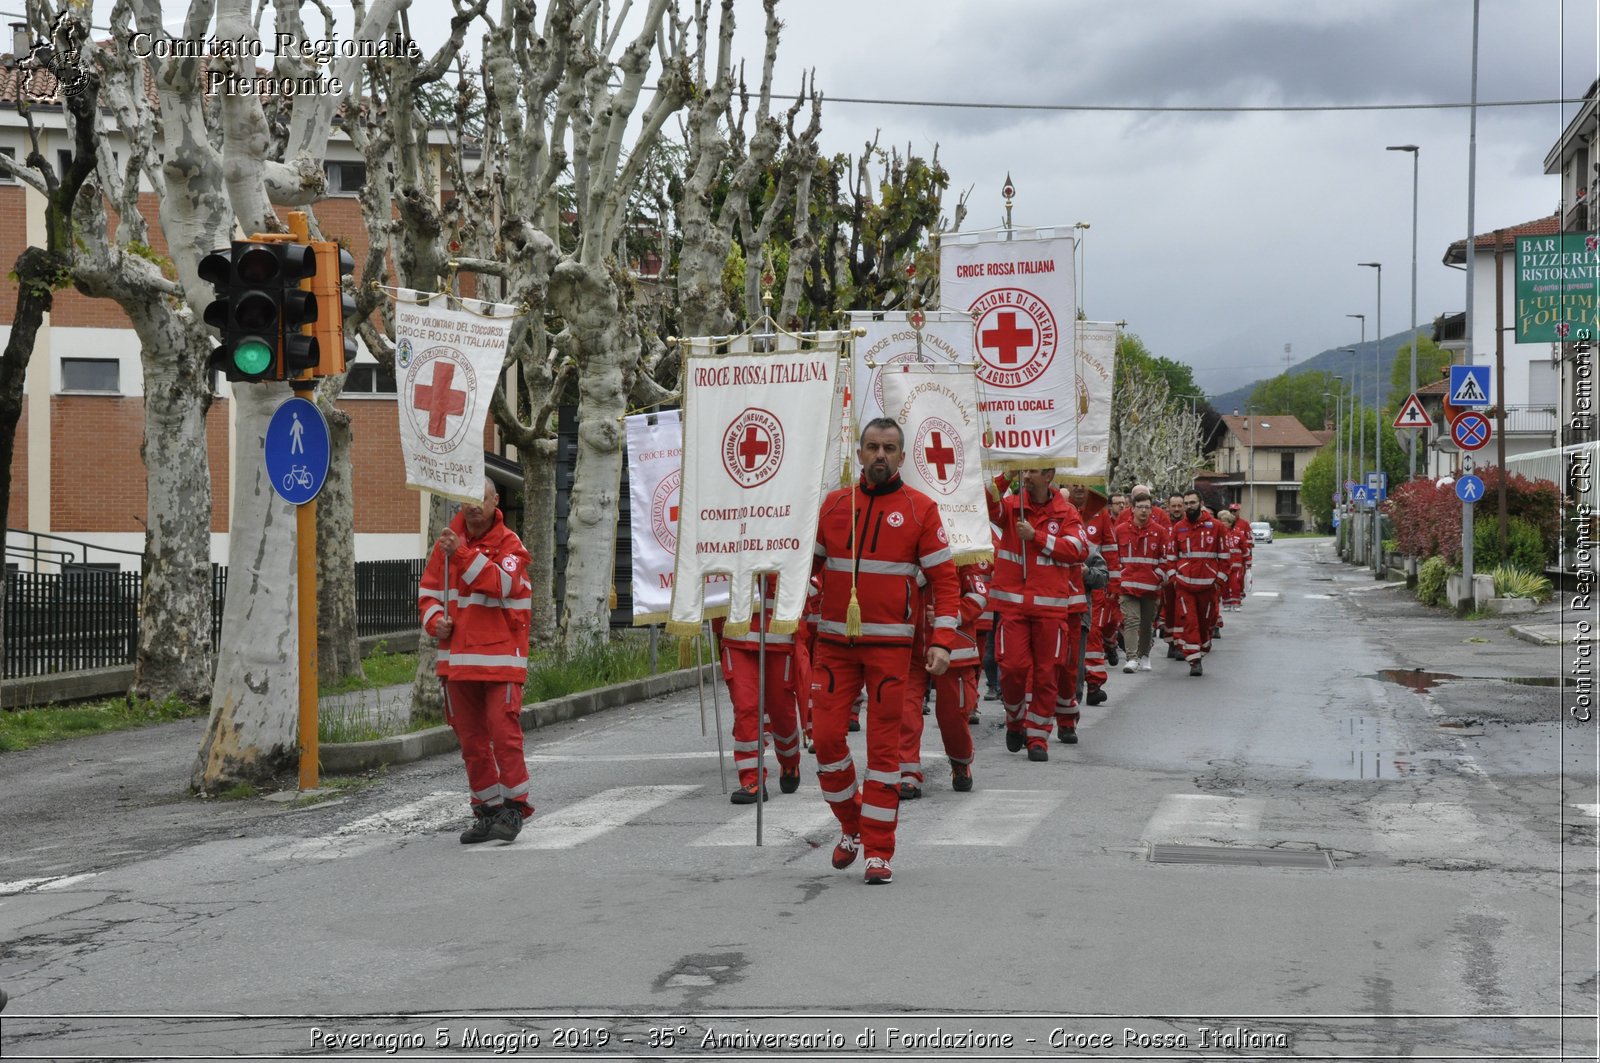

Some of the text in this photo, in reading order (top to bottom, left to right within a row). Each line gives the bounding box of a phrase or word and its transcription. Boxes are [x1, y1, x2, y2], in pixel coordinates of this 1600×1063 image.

[1522, 239, 1555, 252] BAR
[1522, 252, 1600, 267] PIZZERIA
[956, 259, 1055, 278] CROCE ROSSA ITALIANA
[1522, 265, 1600, 281] RISTORANTE
[400, 313, 504, 337] CORPO VOLONTARI DEL SOCCORSO
[1016, 293, 1028, 304] DI
[1028, 301, 1053, 347] GINEVRA
[396, 325, 505, 349] CROCE ROSSA ITALIANA
[864, 331, 960, 362] CROCE ROSS ITALIANA
[408, 347, 449, 383] CONVENZIONE
[451, 351, 460, 360] DI
[986, 369, 1021, 385] AGOSTO
[1022, 360, 1044, 380] 1864
[695, 361, 828, 387] CROCE ROSSA ITALIANA
[898, 390, 917, 426] CROCE
[914, 381, 941, 394] ROSSA
[942, 386, 971, 427] ITALIANA
[976, 399, 1055, 412] MITATO LOCALE
[767, 421, 777, 433] 22
[1005, 414, 1016, 425] di
[638, 450, 665, 462] CROCE
[726, 430, 745, 482] ONVENZIONE
[770, 433, 781, 466] AGOSTO
[444, 461, 473, 475] LOCALE
[660, 480, 673, 493] DI
[749, 504, 791, 518] LOCALE
[937, 504, 978, 513] ATO LOCALE
[743, 538, 764, 551] DEL
[766, 537, 800, 551] BOSCO
[947, 533, 972, 544] SCA
